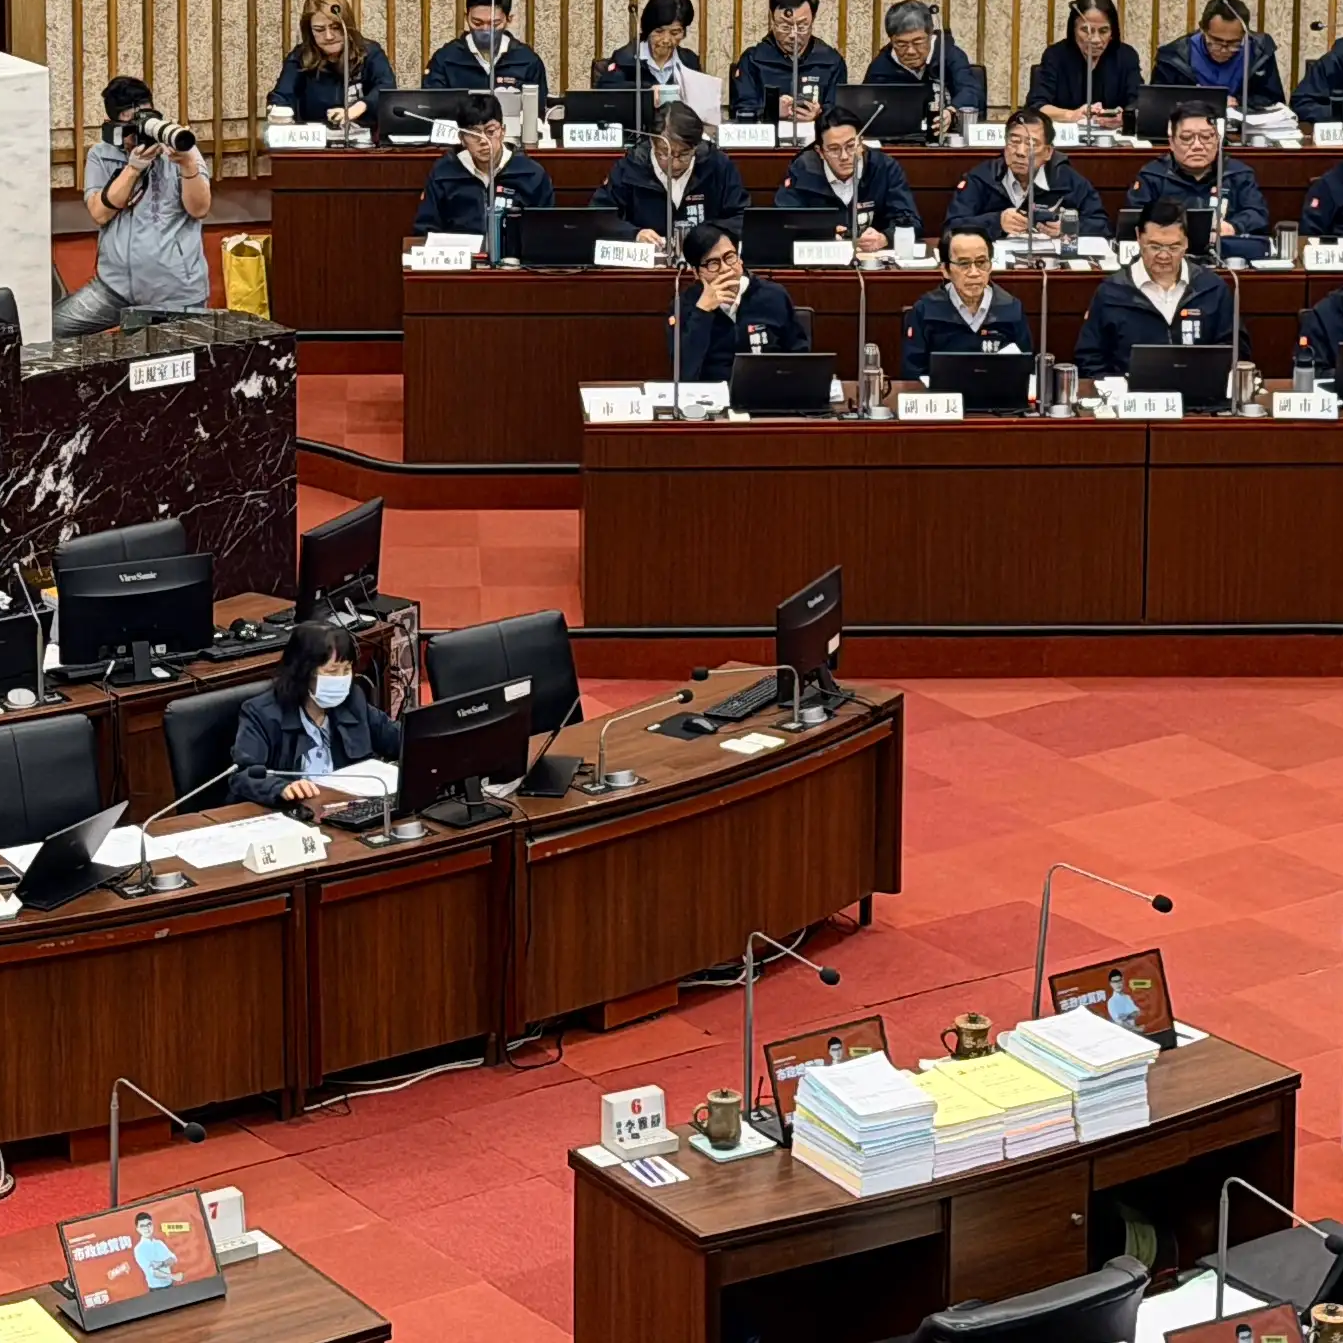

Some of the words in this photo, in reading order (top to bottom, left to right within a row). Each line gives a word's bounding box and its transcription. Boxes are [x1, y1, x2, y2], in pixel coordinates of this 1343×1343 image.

[600, 246, 650, 263] 新聞局長
[133, 359, 192, 386] 法規室主任
[602, 402, 642, 417] 市長
[905, 399, 959, 415] 副市長
[1124, 399, 1178, 414] 副市長
[1279, 398, 1333, 413] 副市長
[259, 836, 317, 866] 記錄
[631, 1098, 642, 1115] 6
[208, 1202, 219, 1220] 7
